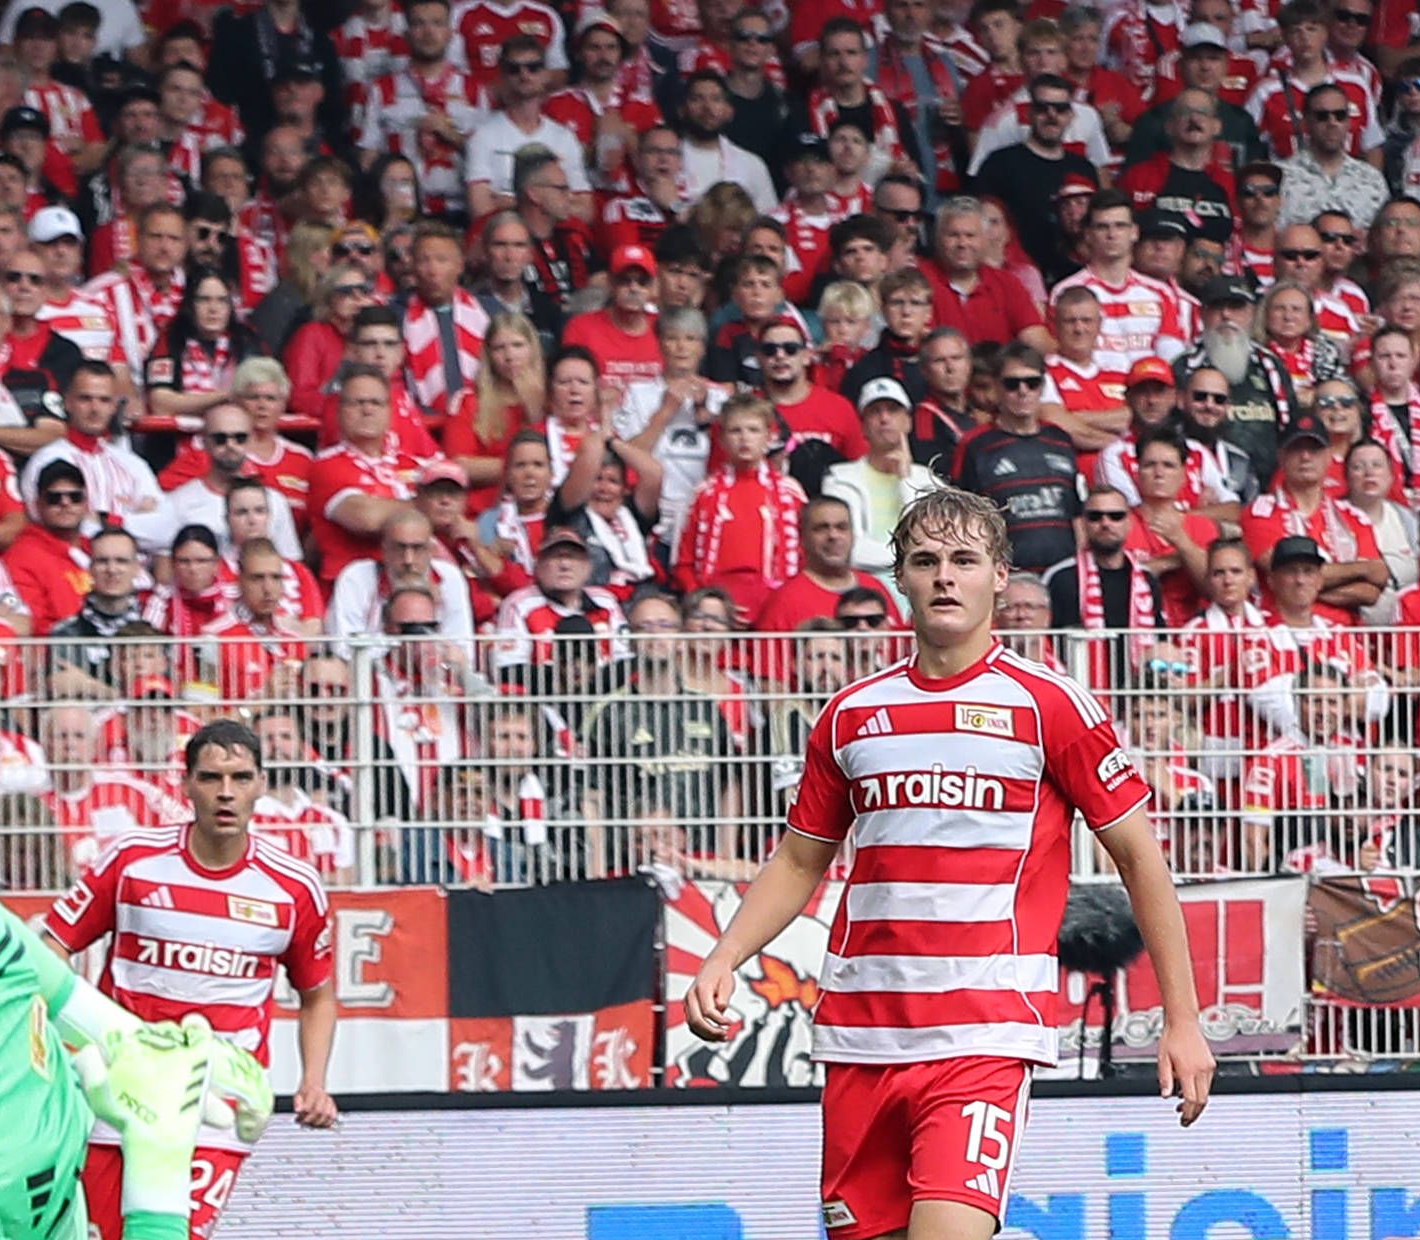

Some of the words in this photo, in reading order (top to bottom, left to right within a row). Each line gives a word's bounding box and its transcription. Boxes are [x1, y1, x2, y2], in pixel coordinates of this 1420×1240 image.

[887, 762, 1005, 810] raisin
[163, 940, 259, 978] raisin
[961, 1100, 1011, 1170] 15
[190, 1160, 235, 1211] 24
